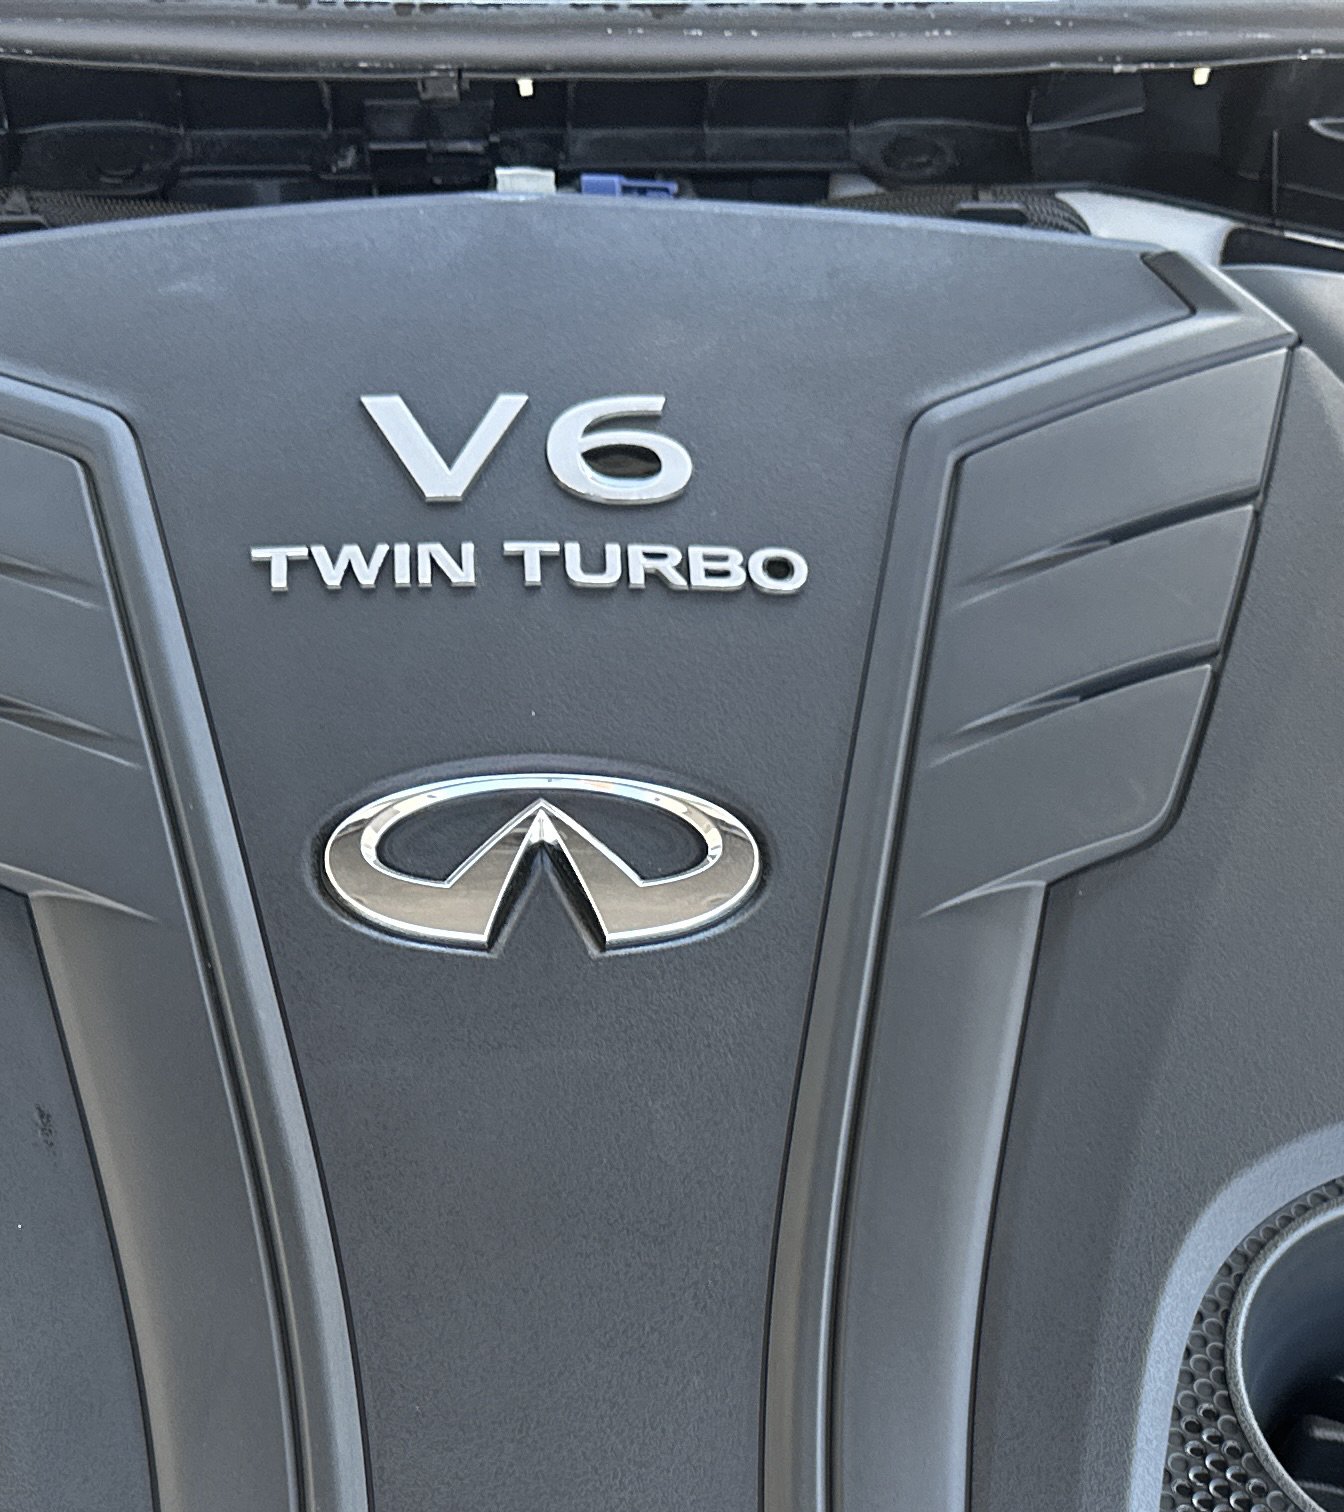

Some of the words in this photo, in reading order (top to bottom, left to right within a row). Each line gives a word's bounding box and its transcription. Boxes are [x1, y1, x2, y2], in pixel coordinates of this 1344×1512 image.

[360, 394, 692, 505] V6
[251, 542, 477, 591] TWIN
[503, 542, 808, 595] TURBO
